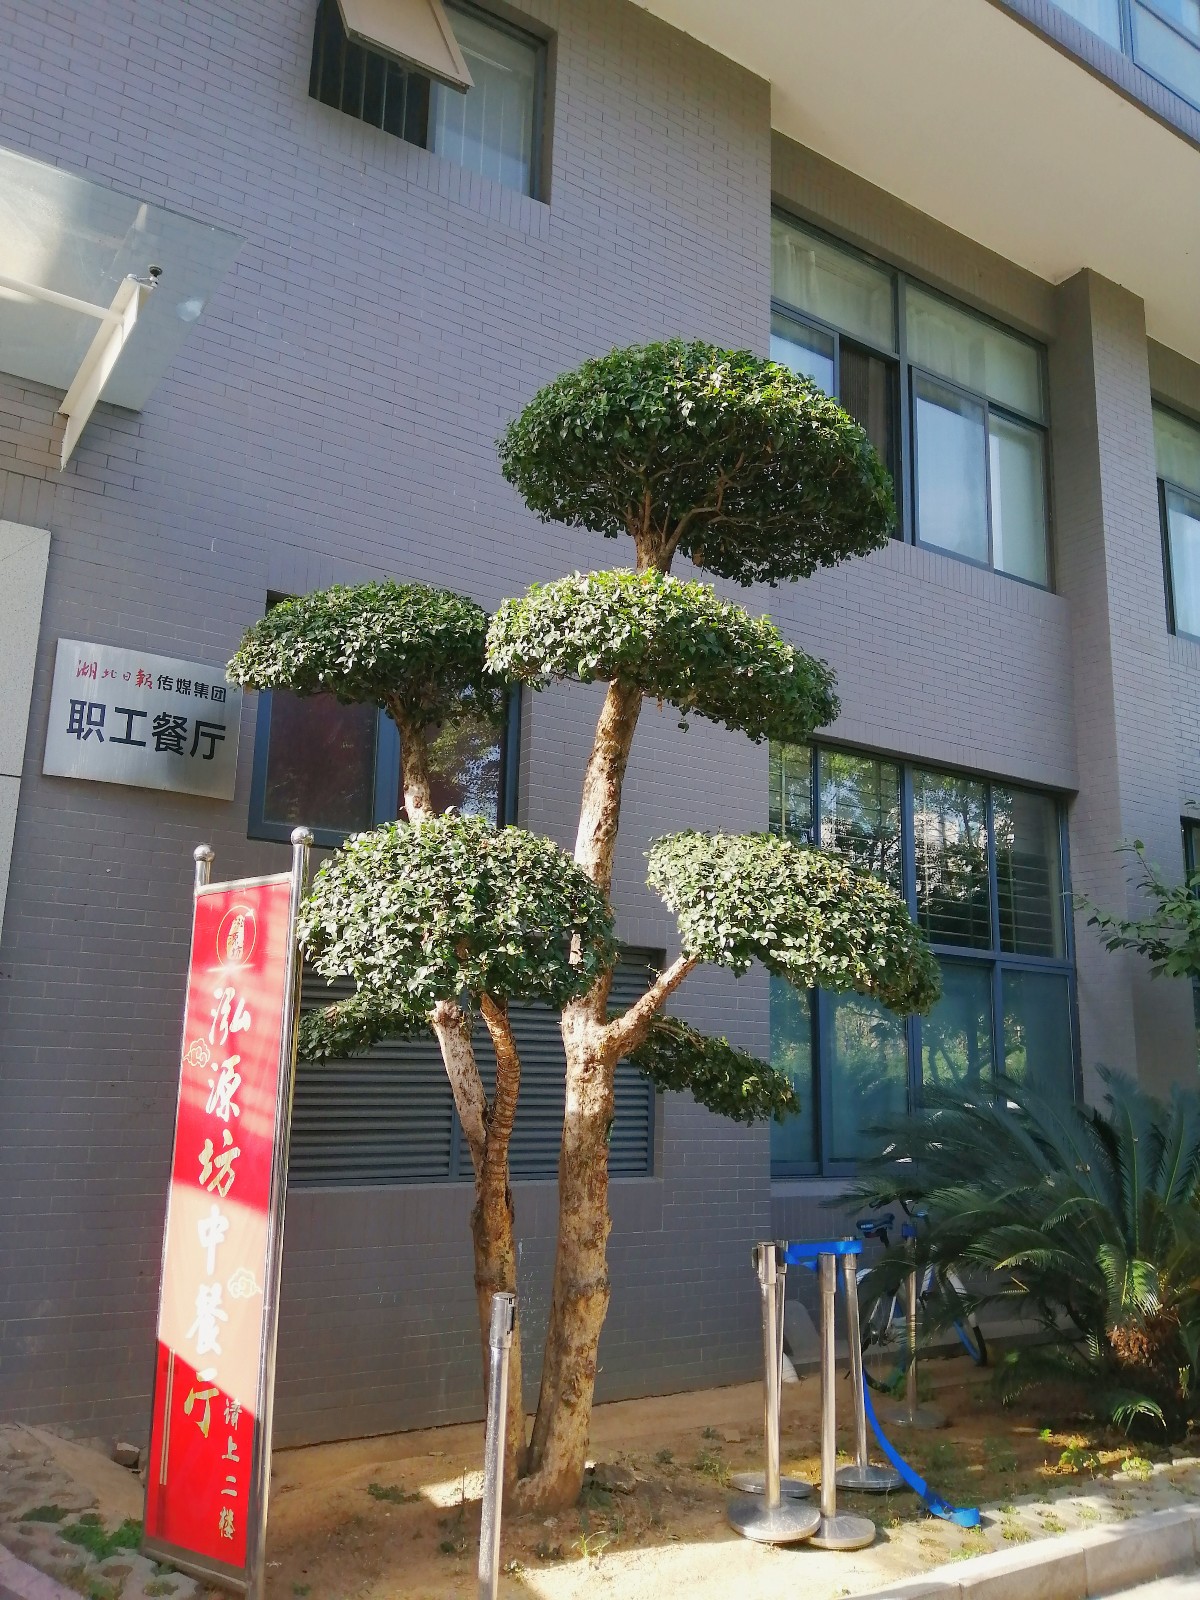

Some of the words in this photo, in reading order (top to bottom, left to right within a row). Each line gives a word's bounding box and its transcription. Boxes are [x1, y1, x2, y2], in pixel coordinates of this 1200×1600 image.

[66, 698, 226, 760] 职工餐厅
[219, 1398, 242, 1540] 请上二楼
